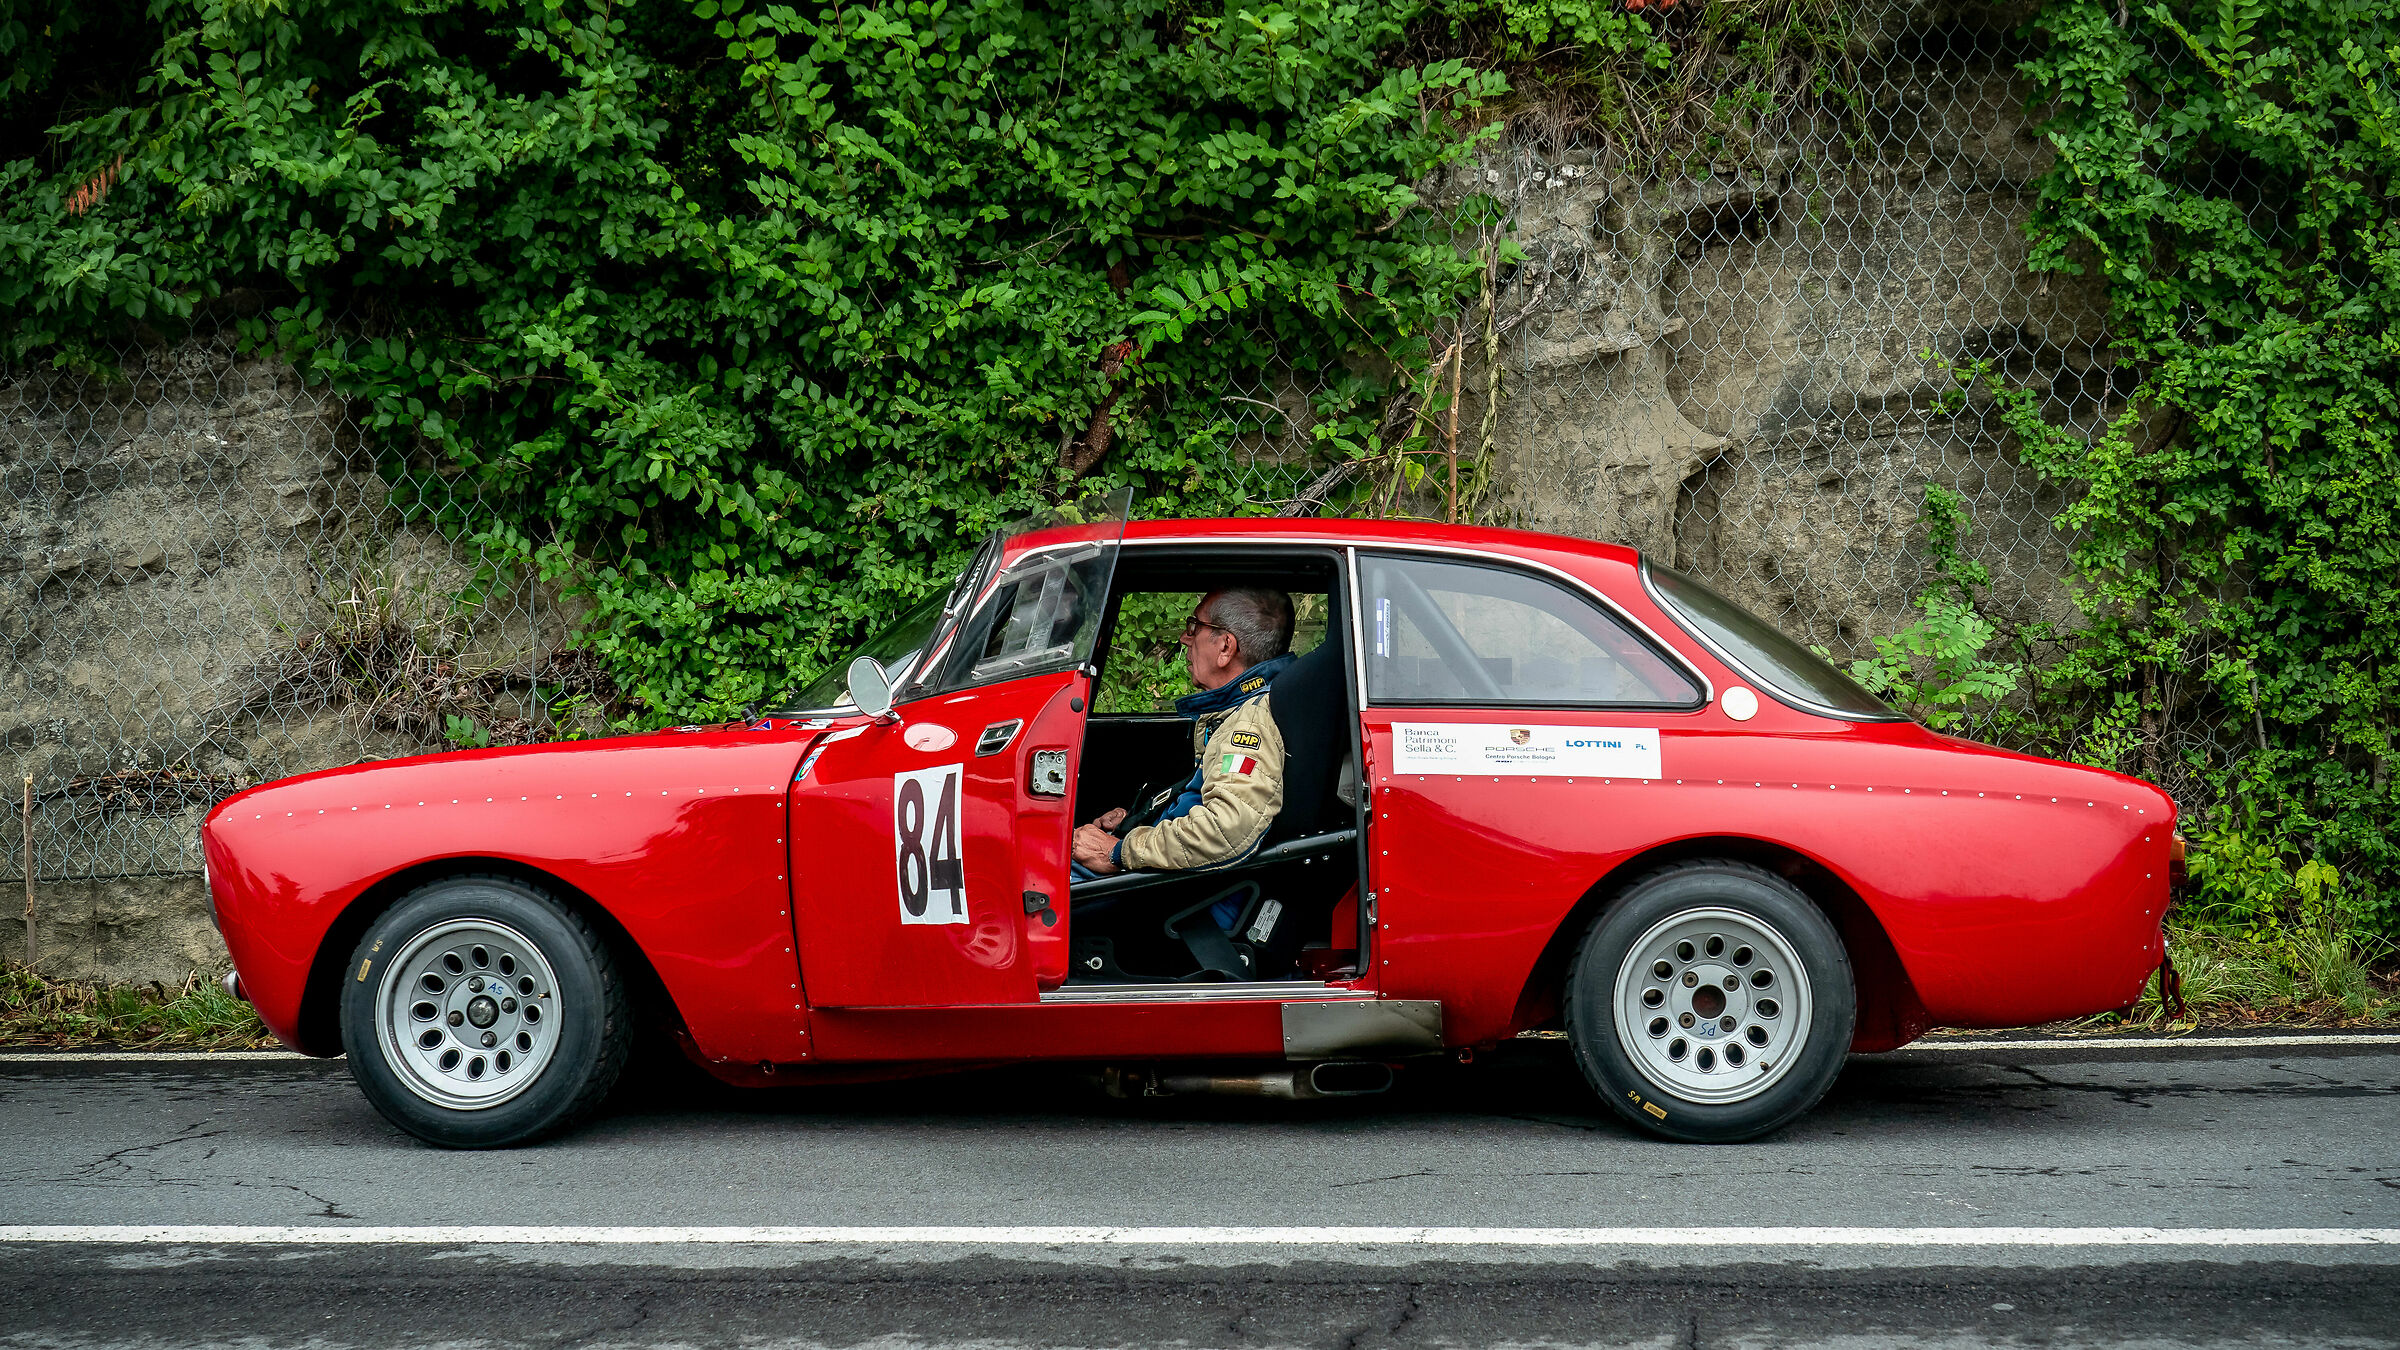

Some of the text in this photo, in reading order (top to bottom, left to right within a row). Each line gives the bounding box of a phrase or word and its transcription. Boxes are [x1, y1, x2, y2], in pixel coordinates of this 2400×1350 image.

[1242, 678, 1263, 692] OMP
[1405, 728, 1439, 736] Banca
[1405, 736, 1457, 744] Patrimoni
[1566, 740, 1621, 748] LOTTINI
[1405, 744, 1457, 753] Sella & C.
[898, 773, 963, 916] 84
[488, 982, 504, 995] AS
